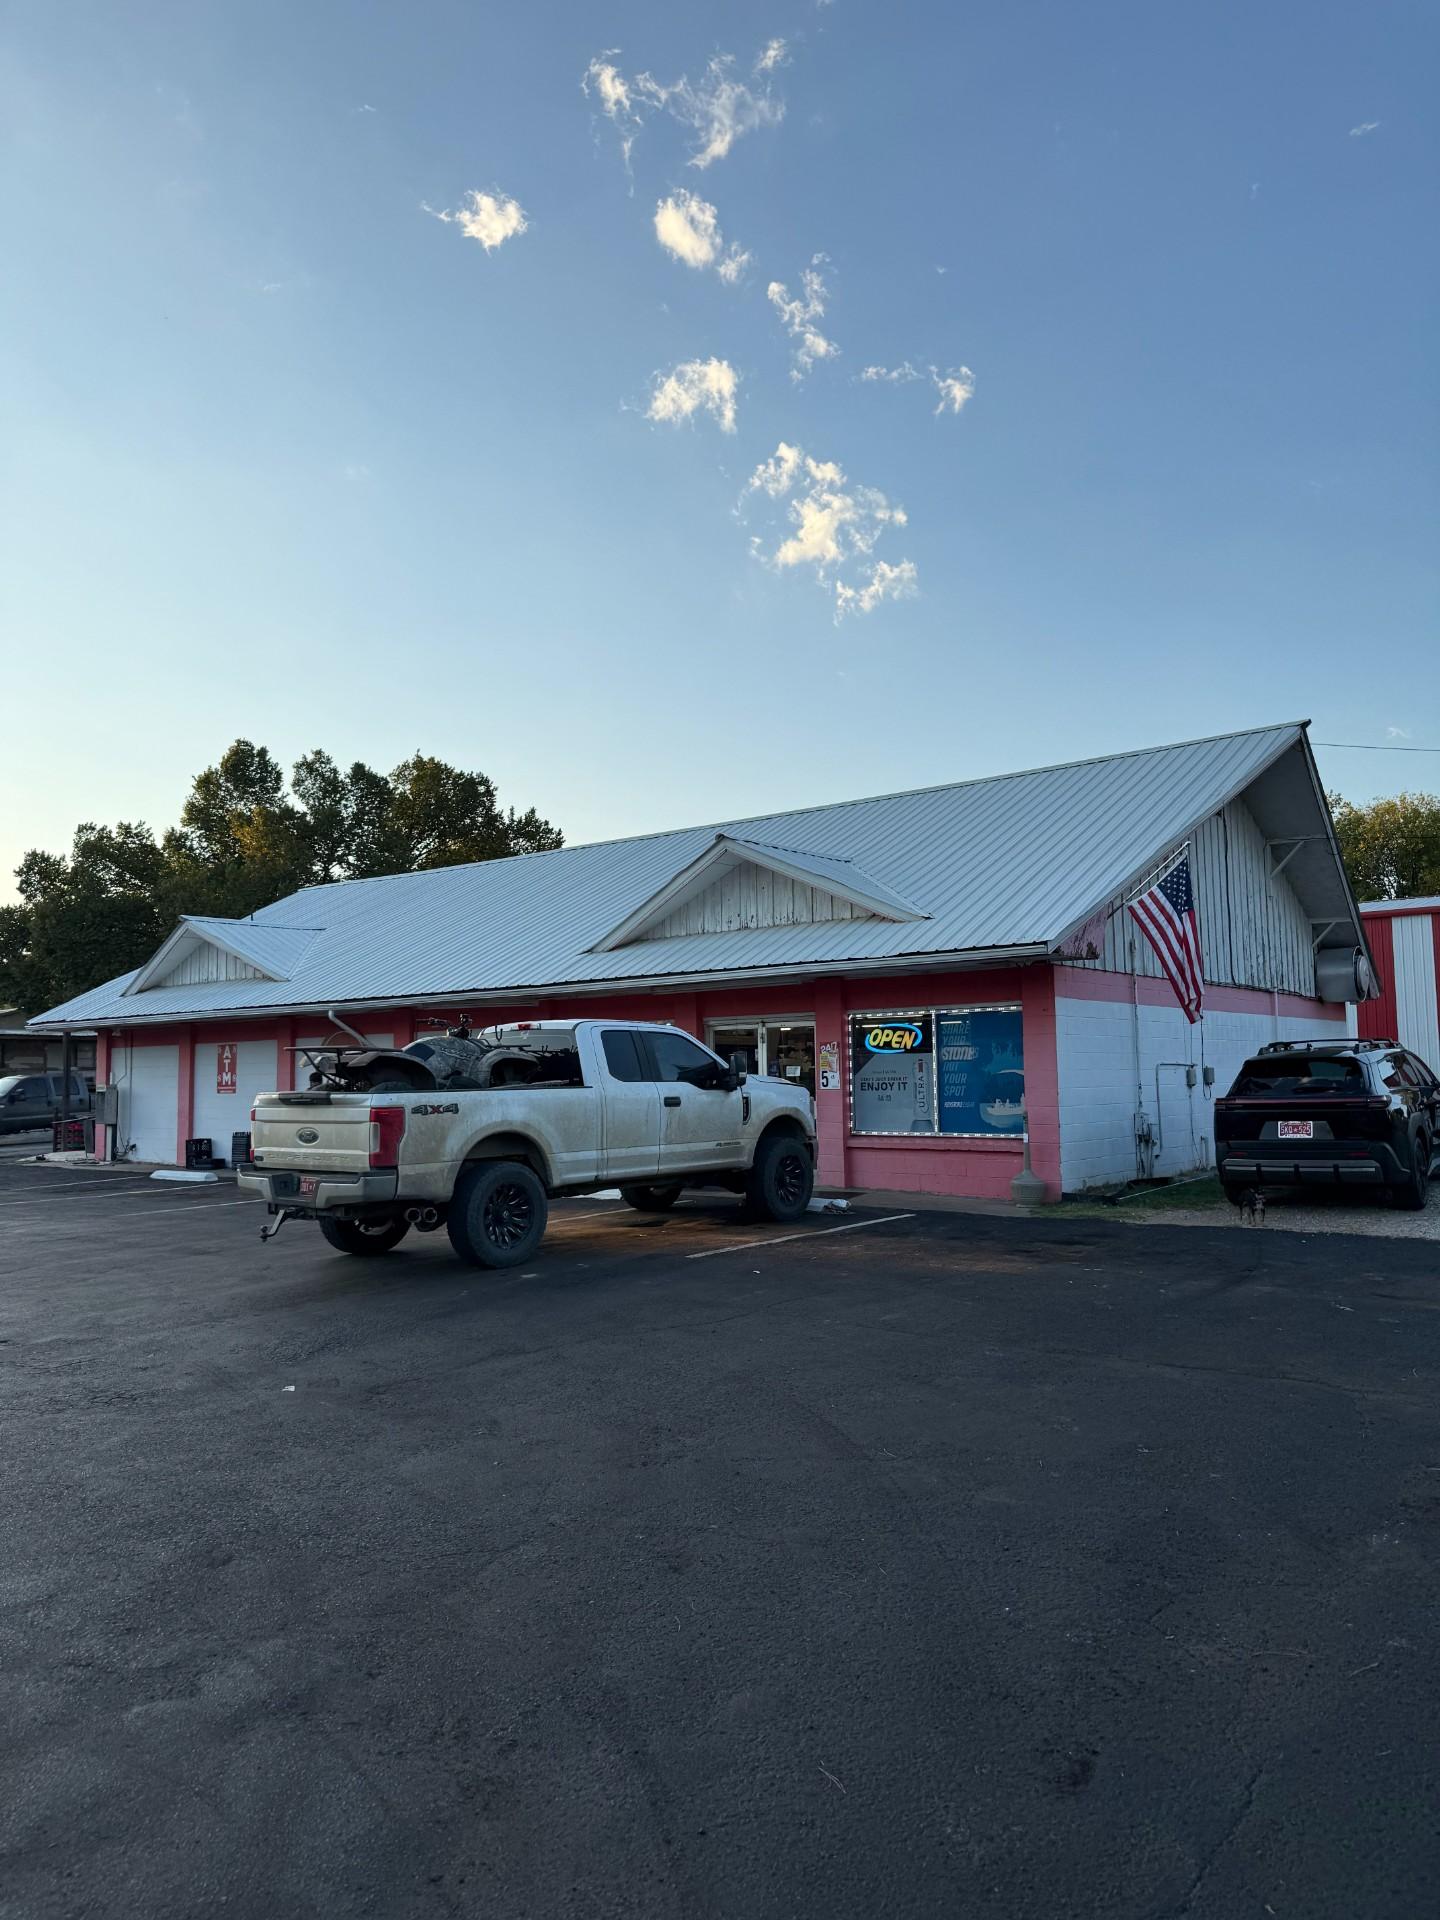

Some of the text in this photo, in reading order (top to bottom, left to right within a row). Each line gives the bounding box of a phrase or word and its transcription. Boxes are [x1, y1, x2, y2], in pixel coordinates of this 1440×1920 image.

[820, 1041, 838, 1053] 24/7
[869, 1029, 916, 1050] OPEN
[223, 1045, 232, 1086] ATM
[821, 1070, 829, 1088] 5
[944, 1072, 967, 1084] YOUR
[860, 1081, 908, 1092] ENJOY IT
[917, 1076, 926, 1108] ULTRA
[944, 1085, 966, 1097] SPOT
